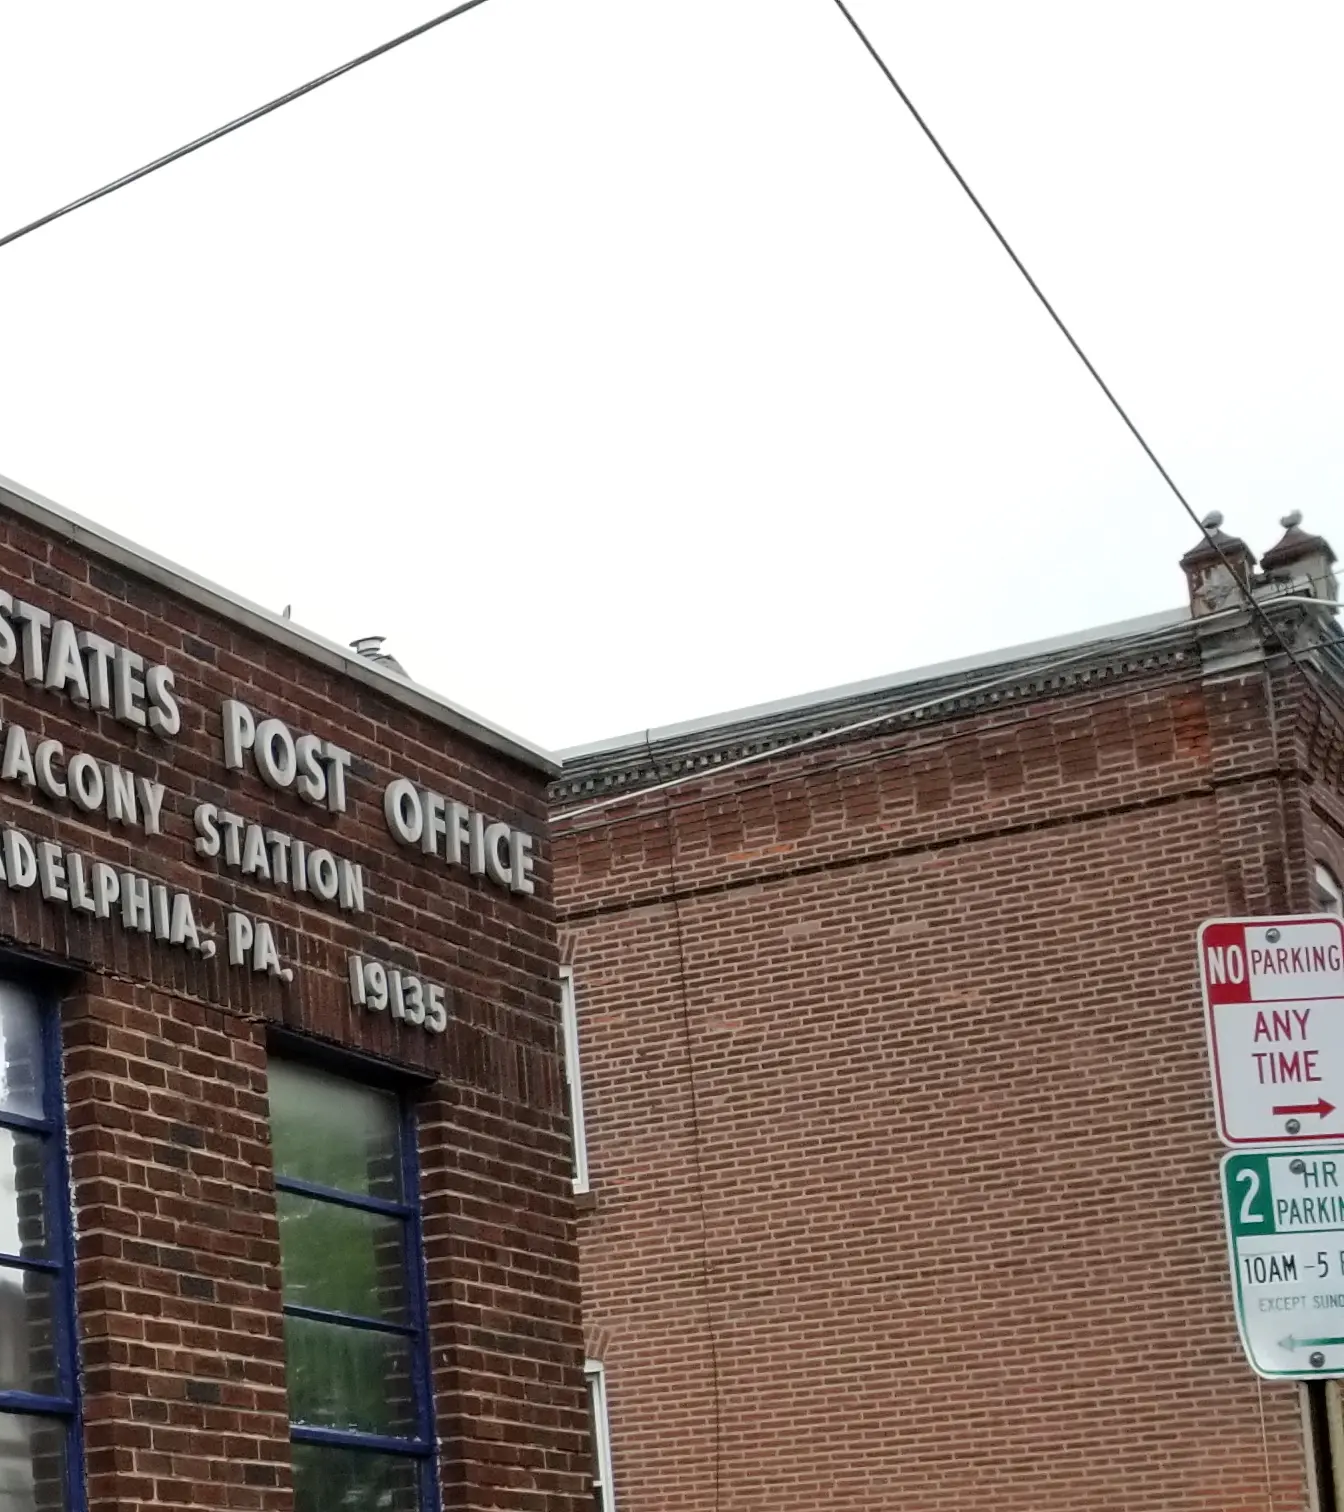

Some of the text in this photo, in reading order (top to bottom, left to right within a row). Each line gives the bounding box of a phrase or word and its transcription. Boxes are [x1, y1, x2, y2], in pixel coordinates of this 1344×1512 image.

[222, 699, 352, 813] POST
[383, 778, 535, 895] OFFICE
[194, 802, 365, 913] STATION
[227, 911, 294, 982] PA.
[349, 955, 448, 1034] 19135
[1207, 944, 1341, 985] NO PARKING
[1254, 1008, 1311, 1042] ANY
[1251, 1049, 1322, 1084] TIME
[1235, 1161, 1338, 1224] 2 HR
[1244, 1254, 1298, 1284] 10AM
[1258, 1295, 1306, 1312] EXCEPT
